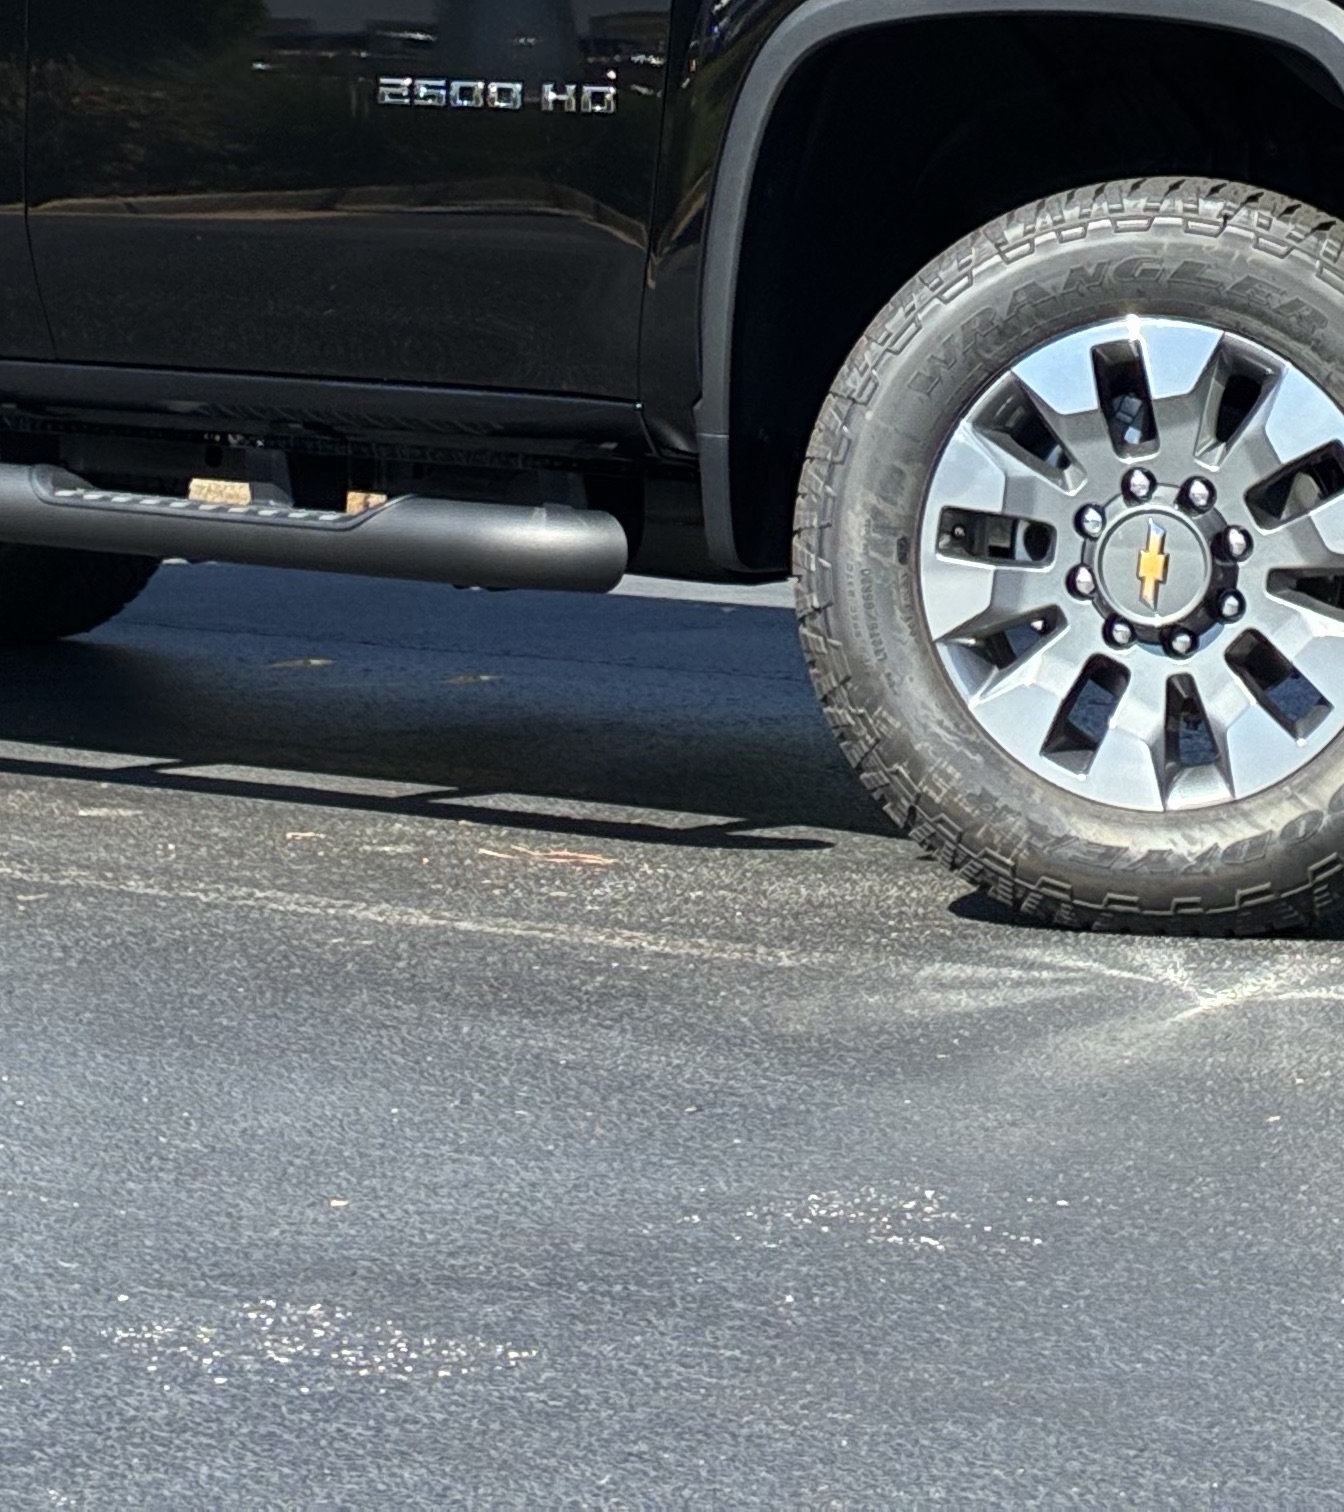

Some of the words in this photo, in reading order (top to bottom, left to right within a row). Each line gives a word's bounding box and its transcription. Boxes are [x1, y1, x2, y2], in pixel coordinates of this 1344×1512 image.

[377, 77, 523, 110] 2500
[541, 83, 616, 113] HD
[909, 255, 1329, 395] WRANGLER
